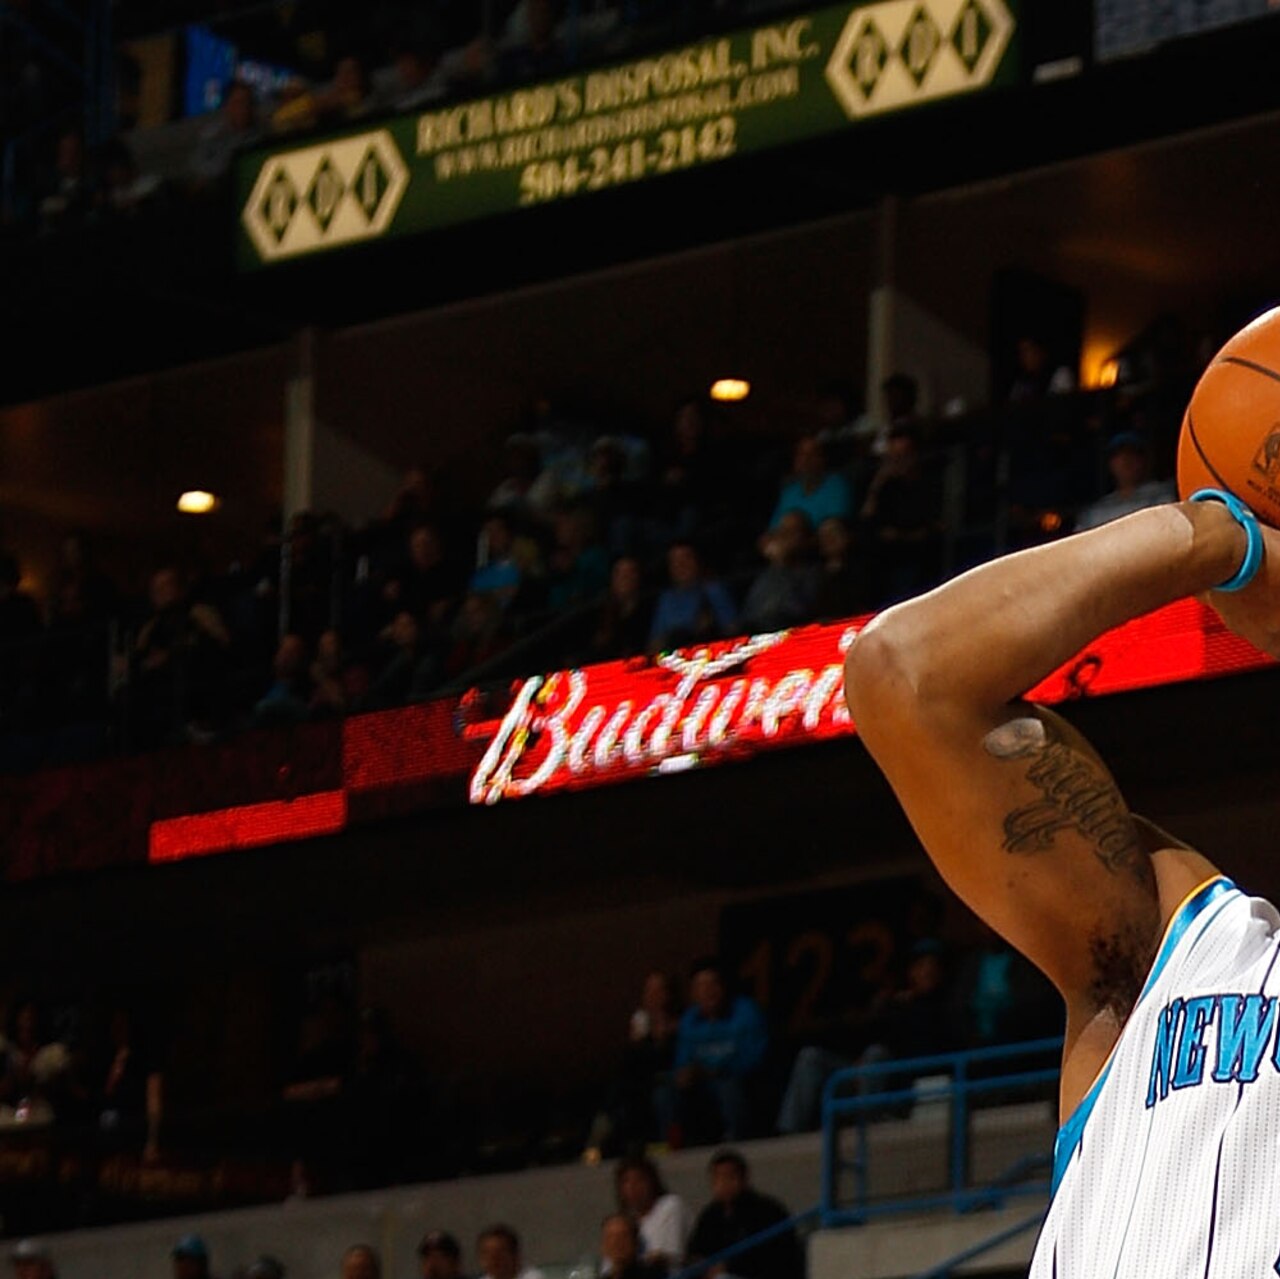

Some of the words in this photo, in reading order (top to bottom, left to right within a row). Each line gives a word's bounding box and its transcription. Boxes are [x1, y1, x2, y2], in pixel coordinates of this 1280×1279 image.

[751, 17, 821, 69] INC.
[518, 115, 738, 207] 504-241-2142
[468, 631, 852, 804] Budwei
